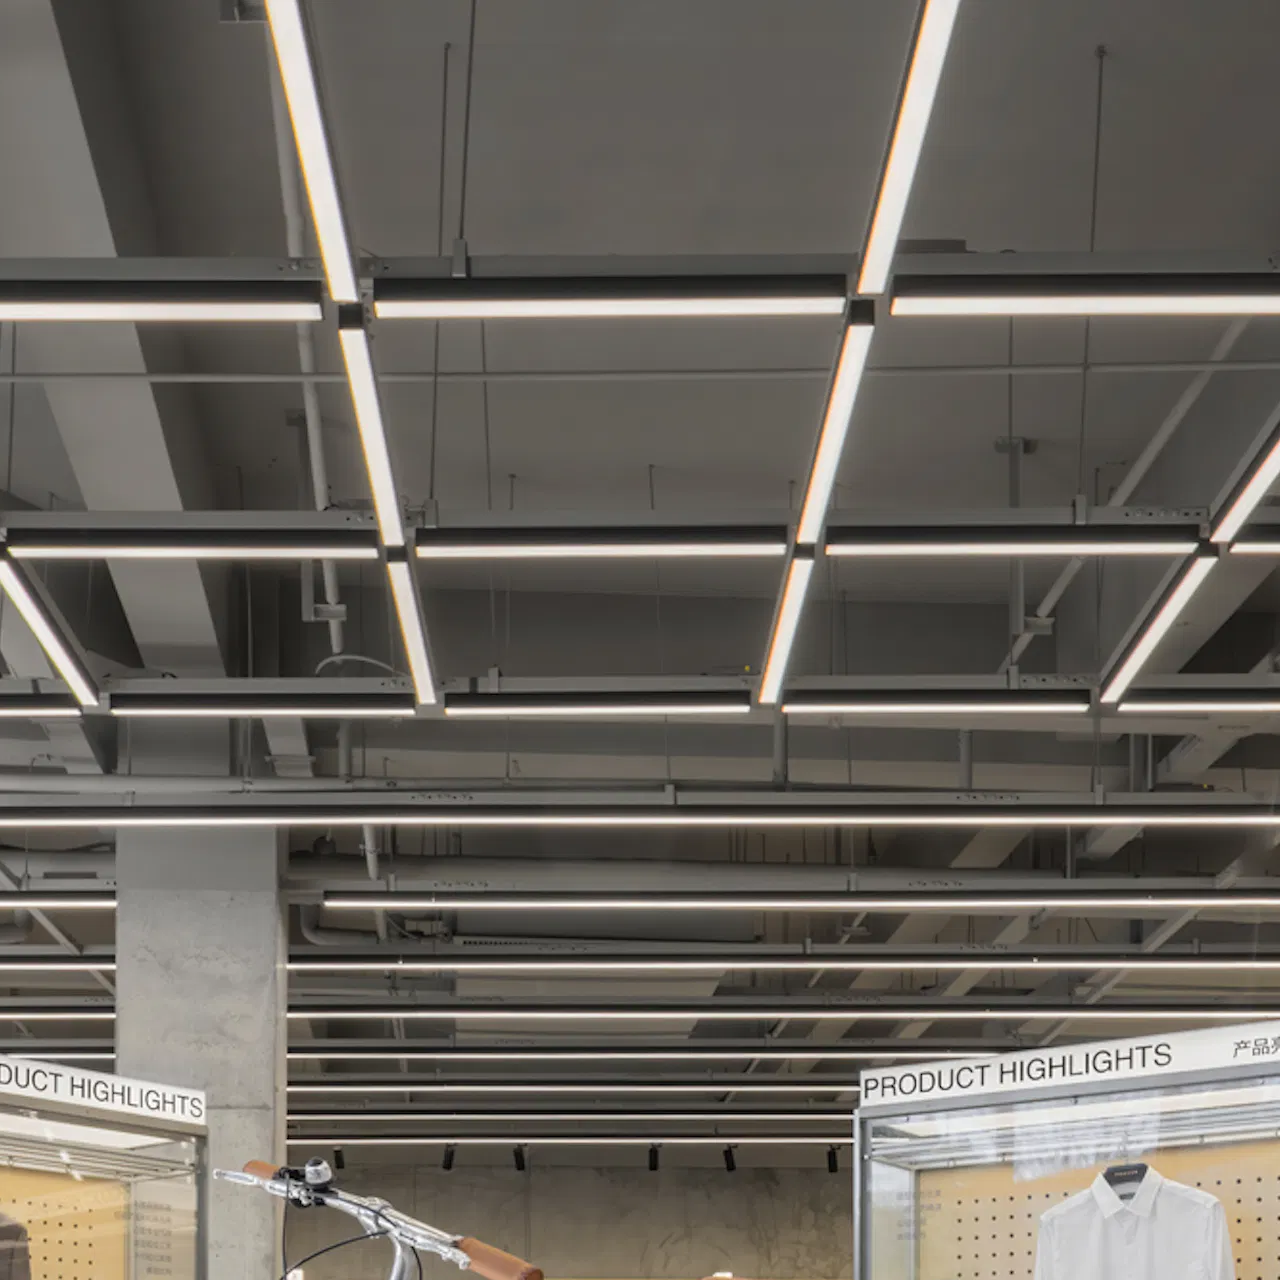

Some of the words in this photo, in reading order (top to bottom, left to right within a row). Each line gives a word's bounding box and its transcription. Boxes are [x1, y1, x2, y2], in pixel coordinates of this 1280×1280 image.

[863, 1064, 992, 1100] PRODUCT
[998, 1042, 1173, 1086] HIGHLIGHTS
[69, 1076, 204, 1119] HIGHLIGHTS
